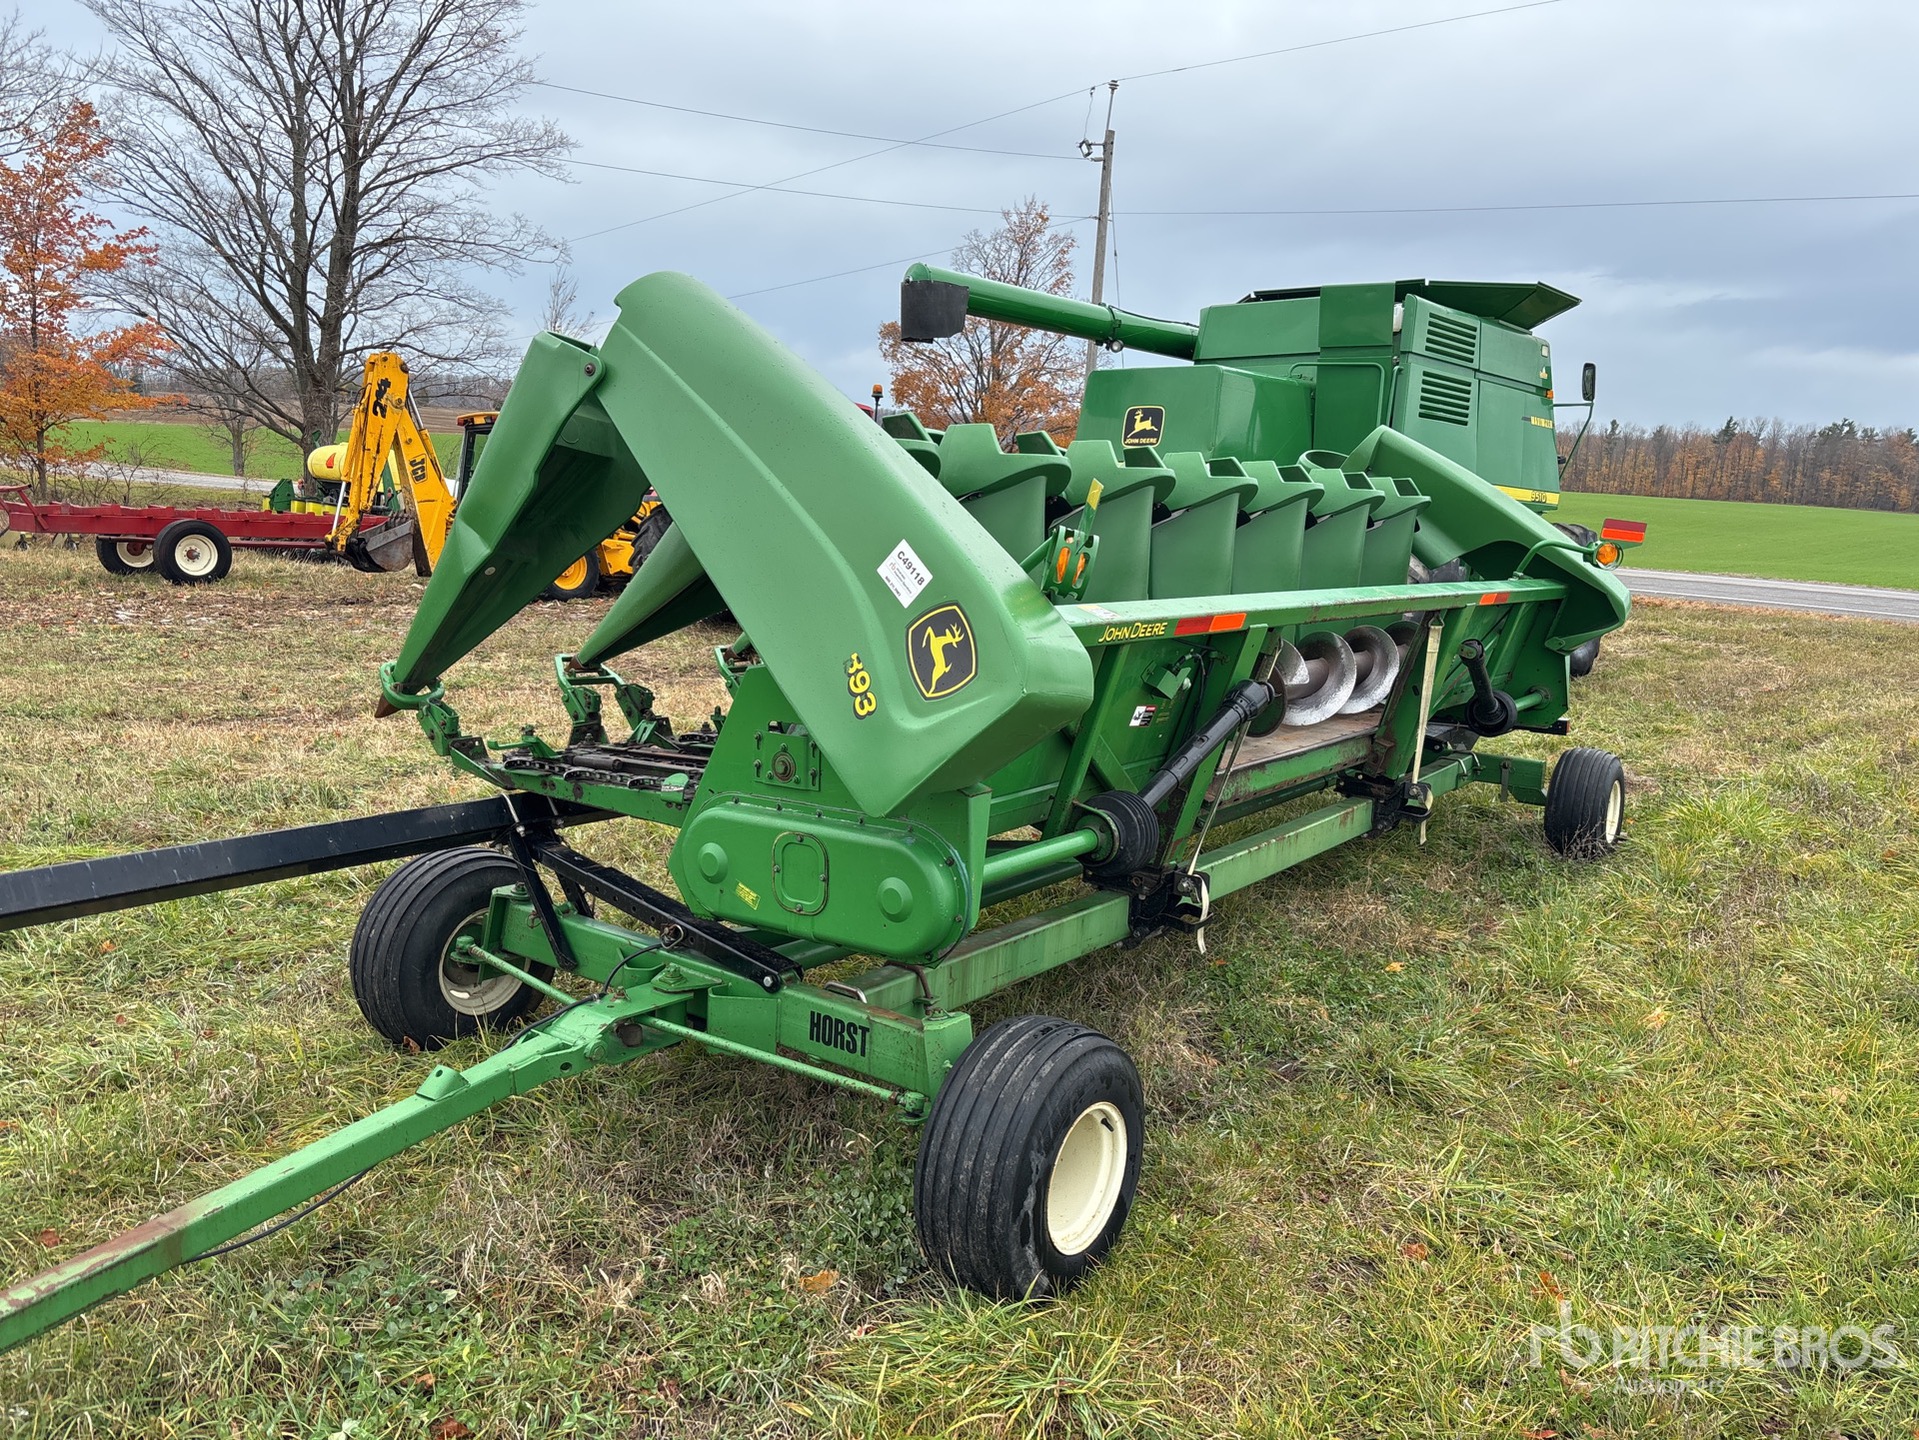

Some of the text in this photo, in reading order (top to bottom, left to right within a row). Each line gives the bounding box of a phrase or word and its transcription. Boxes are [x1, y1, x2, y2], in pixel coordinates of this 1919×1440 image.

[409, 457, 425, 482] JCB
[896, 550, 925, 586] C49118
[1098, 622, 1168, 643] JOHN DEERE
[809, 1010, 870, 1057] HORST
